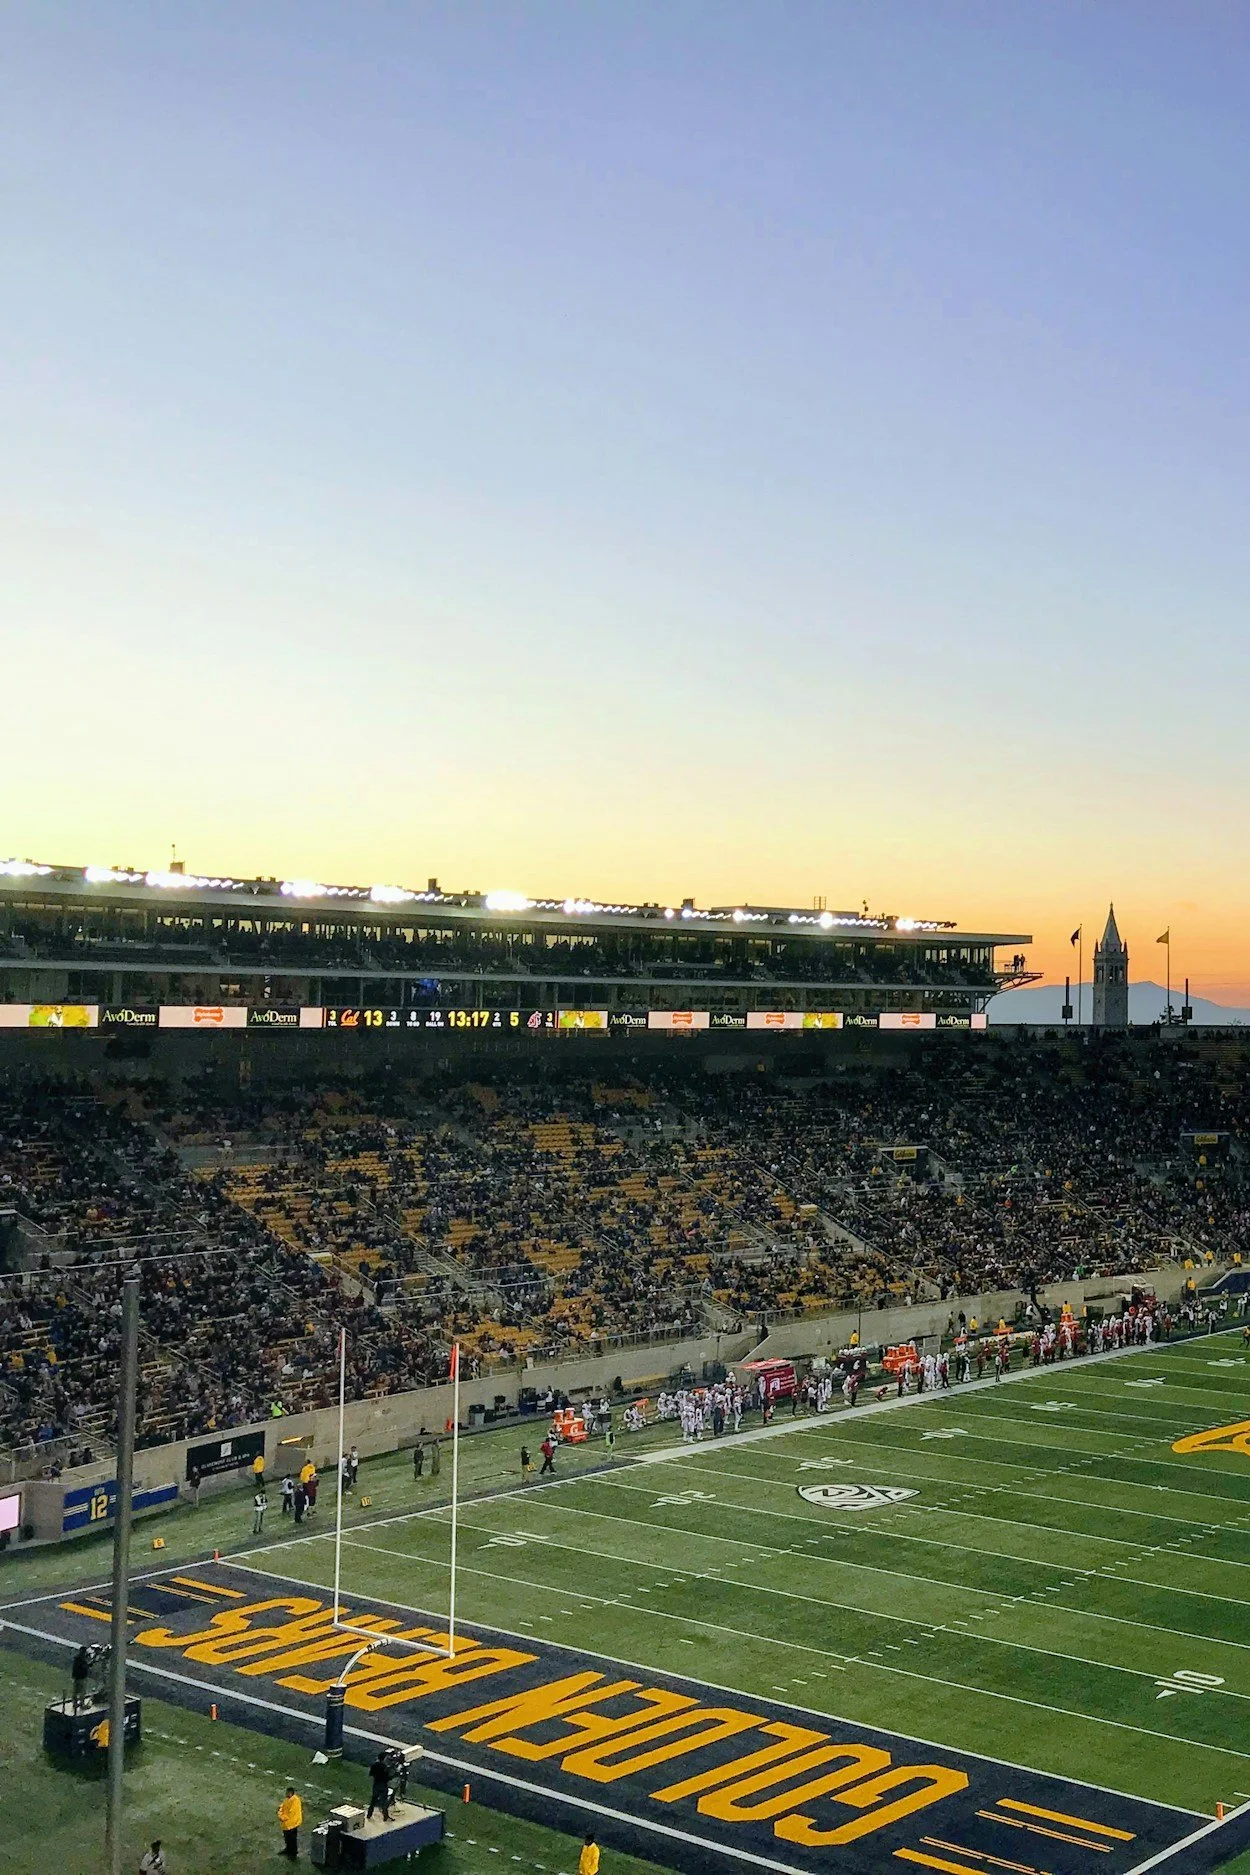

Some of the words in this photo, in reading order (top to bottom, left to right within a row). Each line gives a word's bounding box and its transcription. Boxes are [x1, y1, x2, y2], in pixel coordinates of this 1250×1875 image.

[329, 1010, 336, 1020] 3
[340, 1009, 360, 1026] Cal
[364, 1010, 383, 1026] 13
[390, 1011, 397, 1021] 3
[430, 1011, 441, 1021] 19
[448, 1011, 489, 1027] 13:17
[494, 1012, 500, 1021] 2
[509, 1012, 519, 1026] 5
[547, 1012, 553, 1022] 3
[90, 1494, 108, 1520] 12
[134, 1596, 541, 1711] BEARS
[1154, 1669, 1226, 1695] 10
[423, 1671, 970, 1848] GOLDEN
